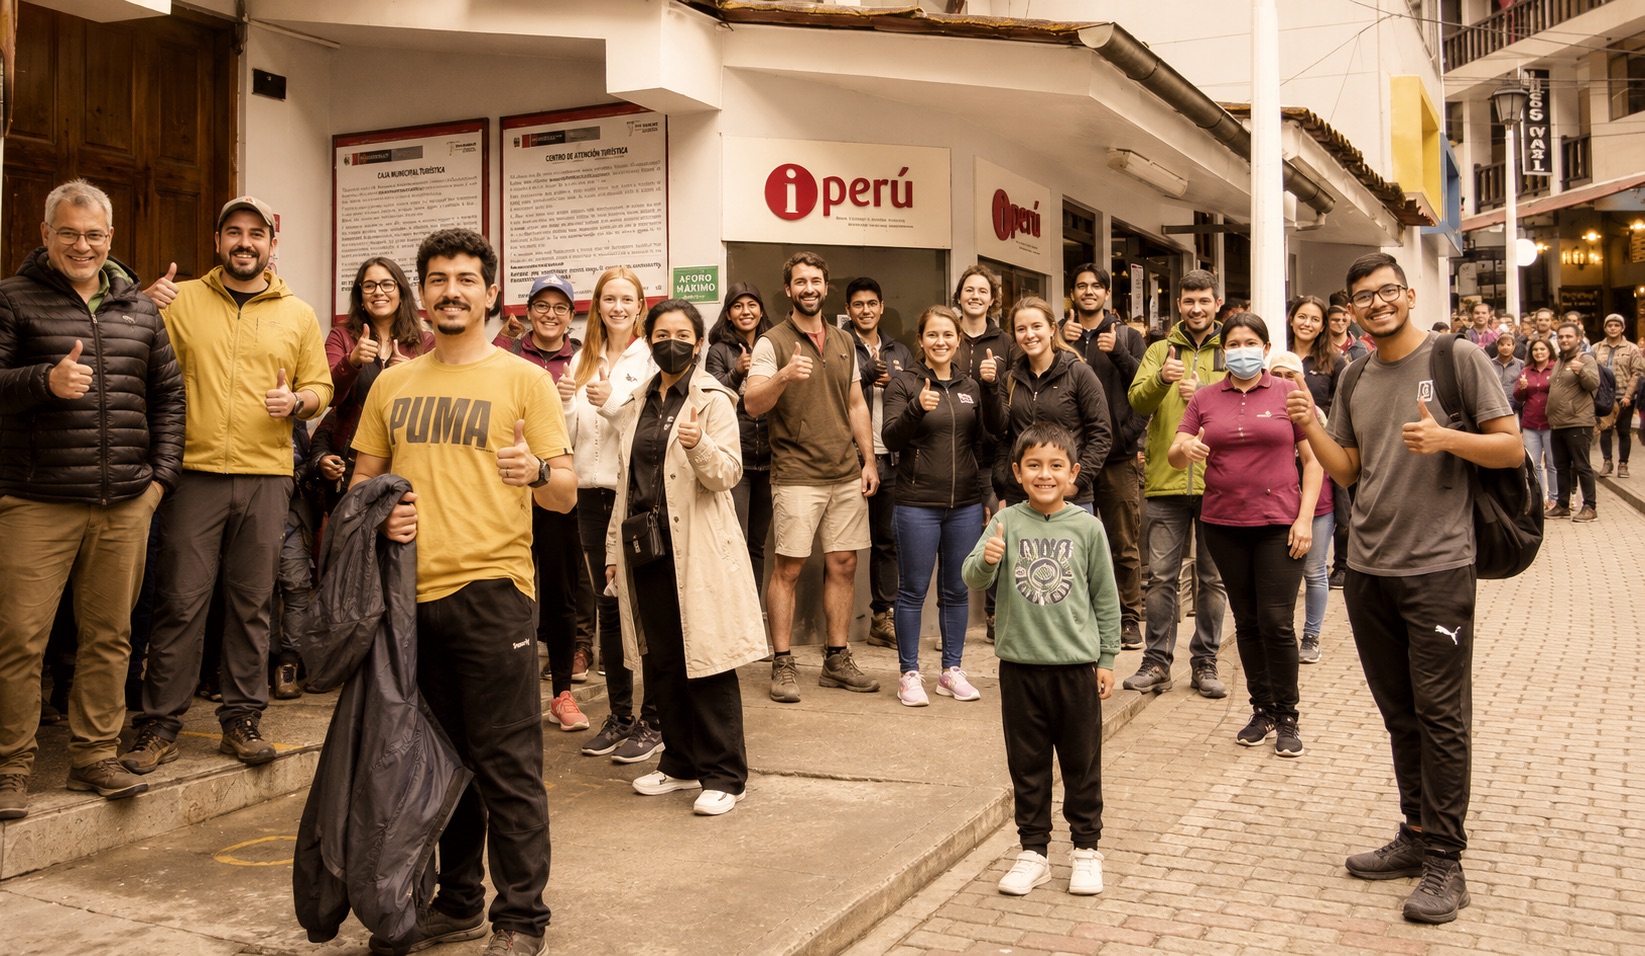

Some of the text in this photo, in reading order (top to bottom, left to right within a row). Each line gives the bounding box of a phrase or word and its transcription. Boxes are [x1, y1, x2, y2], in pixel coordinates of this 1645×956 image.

[567, 152, 573, 160] DE
[823, 166, 913, 216] perú
[679, 273, 712, 284] AFORO
[390, 397, 491, 448] PUMA
